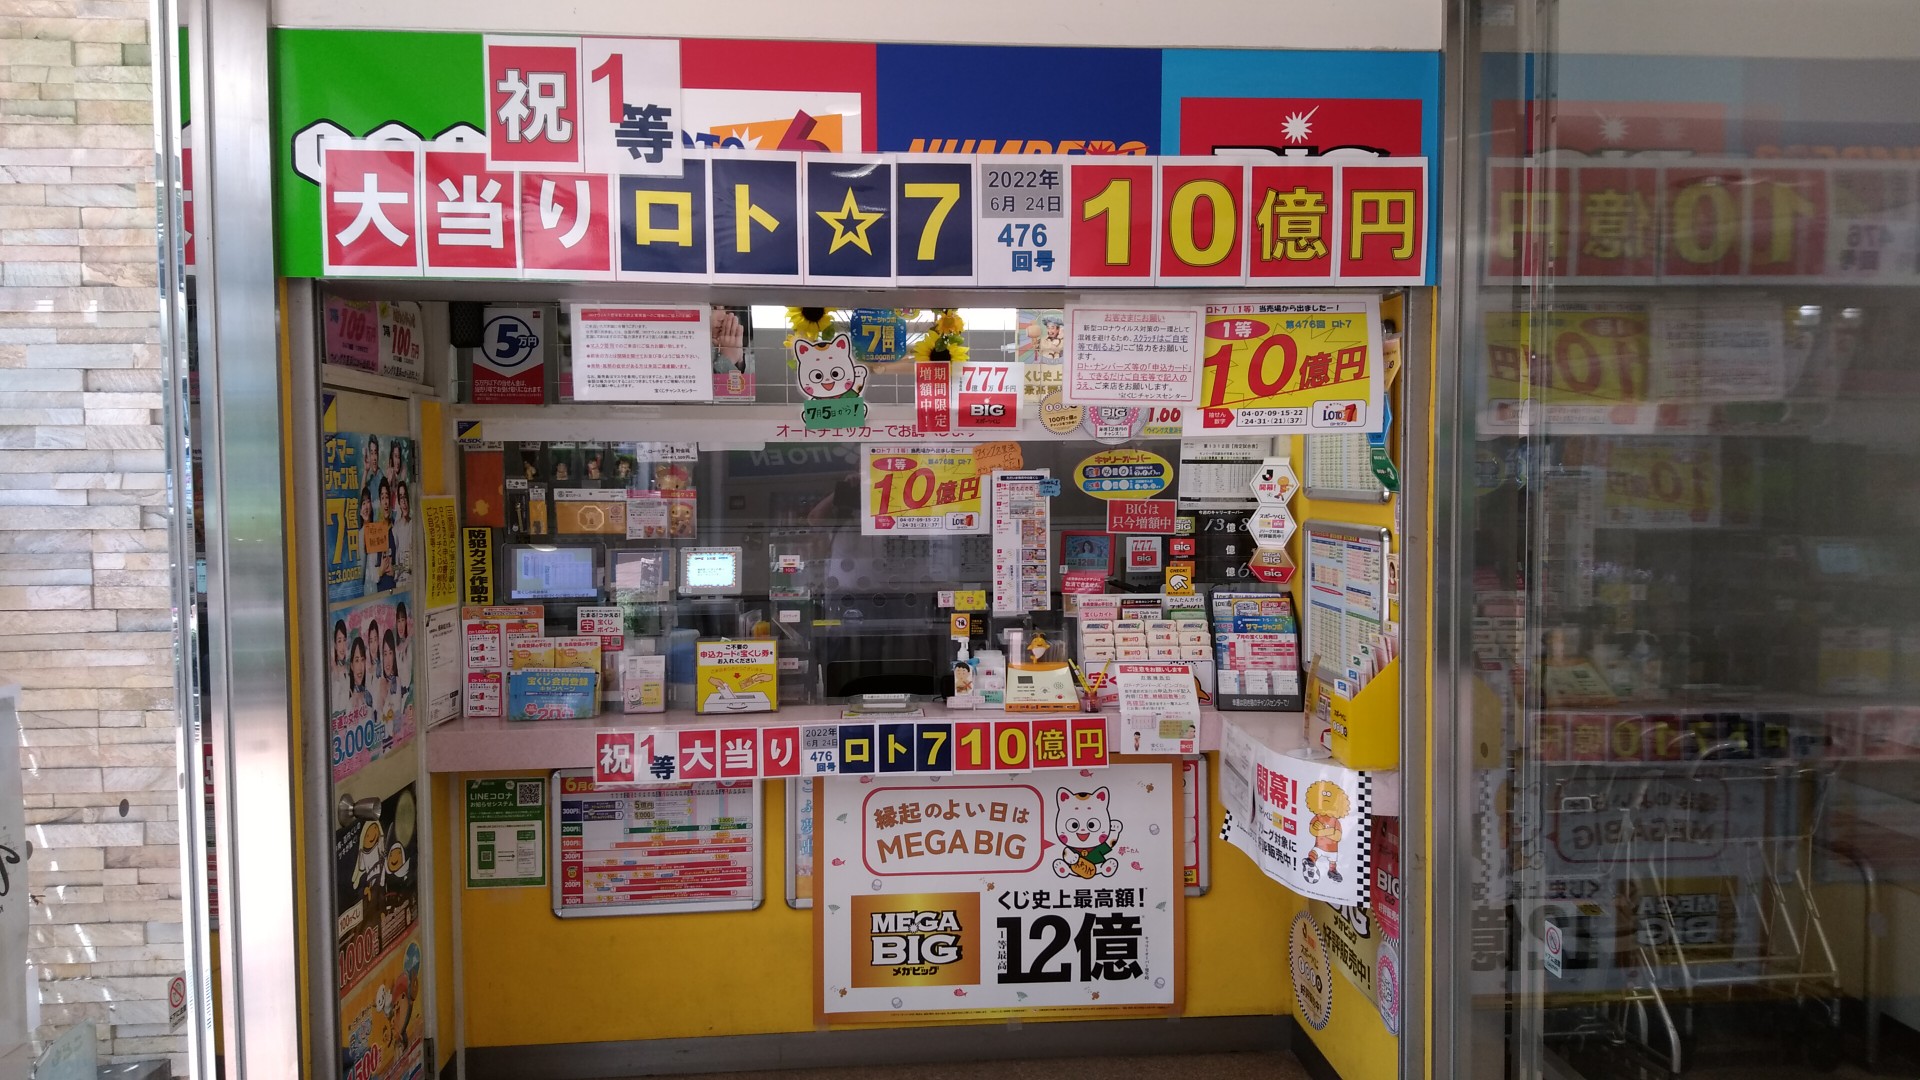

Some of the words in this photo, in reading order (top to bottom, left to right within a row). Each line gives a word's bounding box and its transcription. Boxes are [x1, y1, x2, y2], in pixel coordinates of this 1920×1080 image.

[497, 67, 573, 144] 祝
[591, 53, 673, 163] 1等
[988, 169, 1060, 190] 2022年
[334, 172, 592, 249] 大当り
[990, 196, 1015, 213] 6月
[1026, 195, 1061, 213] 24日
[1082, 178, 1415, 267] 10億円
[998, 223, 1047, 248] 476
[1012, 250, 1055, 273] 回号
[1083, 324, 1190, 333] 新型コロナウイルス対策の一環として
[1104, 313, 1166, 322] お客さまにお願い
[1285, 320, 1326, 330] 第476回
[1331, 320, 1352, 329] ロト7
[496, 323, 537, 359] 5万円
[861, 324, 895, 353] 7億円
[1222, 321, 1253, 339] 1等
[1203, 334, 1368, 407] 10億円
[934, 366, 947, 428] 期間限定
[970, 404, 1006, 417] BIG
[1101, 407, 1128, 417] BIG
[325, 437, 354, 463] サマー
[1094, 454, 1152, 464] キャリーオーバー
[886, 458, 907, 470] 1等
[325, 466, 359, 491] ジャンボ
[874, 468, 981, 515] 10億円
[1125, 503, 1159, 515] BIGは
[326, 497, 361, 565] 7億円
[1112, 516, 1172, 530] 只今増額中
[1173, 543, 1190, 551] BIG
[468, 528, 489, 604] 防犯カメラ作動中
[1126, 665, 1183, 673] ご注意をお願いします
[526, 676, 589, 687] 宝くじ会員登録
[805, 728, 837, 738] 2022年
[806, 739, 818, 747] 6月
[822, 738, 838, 747] 24日
[600, 743, 632, 774] 祝
[640, 734, 676, 780] 1等
[682, 737, 794, 771] 大当り
[810, 750, 833, 762] 476
[845, 730, 948, 766] ロト7
[960, 727, 1104, 766] 10億円
[816, 761, 836, 772] 回号
[470, 792, 513, 801] LINEコロナ
[1256, 763, 1298, 815] 開幕!
[873, 800, 1030, 830] 縁起のよい日は
[876, 829, 965, 863] MEGA
[974, 831, 1027, 860] BIG
[564, 880, 581, 888] 200円
[997, 888, 1146, 910] くじ史上最高額!
[871, 910, 962, 934] MEGA
[871, 933, 962, 967] BIG
[997, 912, 1144, 985] 12億
[997, 929, 1008, 971] 1等最高
[892, 966, 940, 976] メガビッグ
